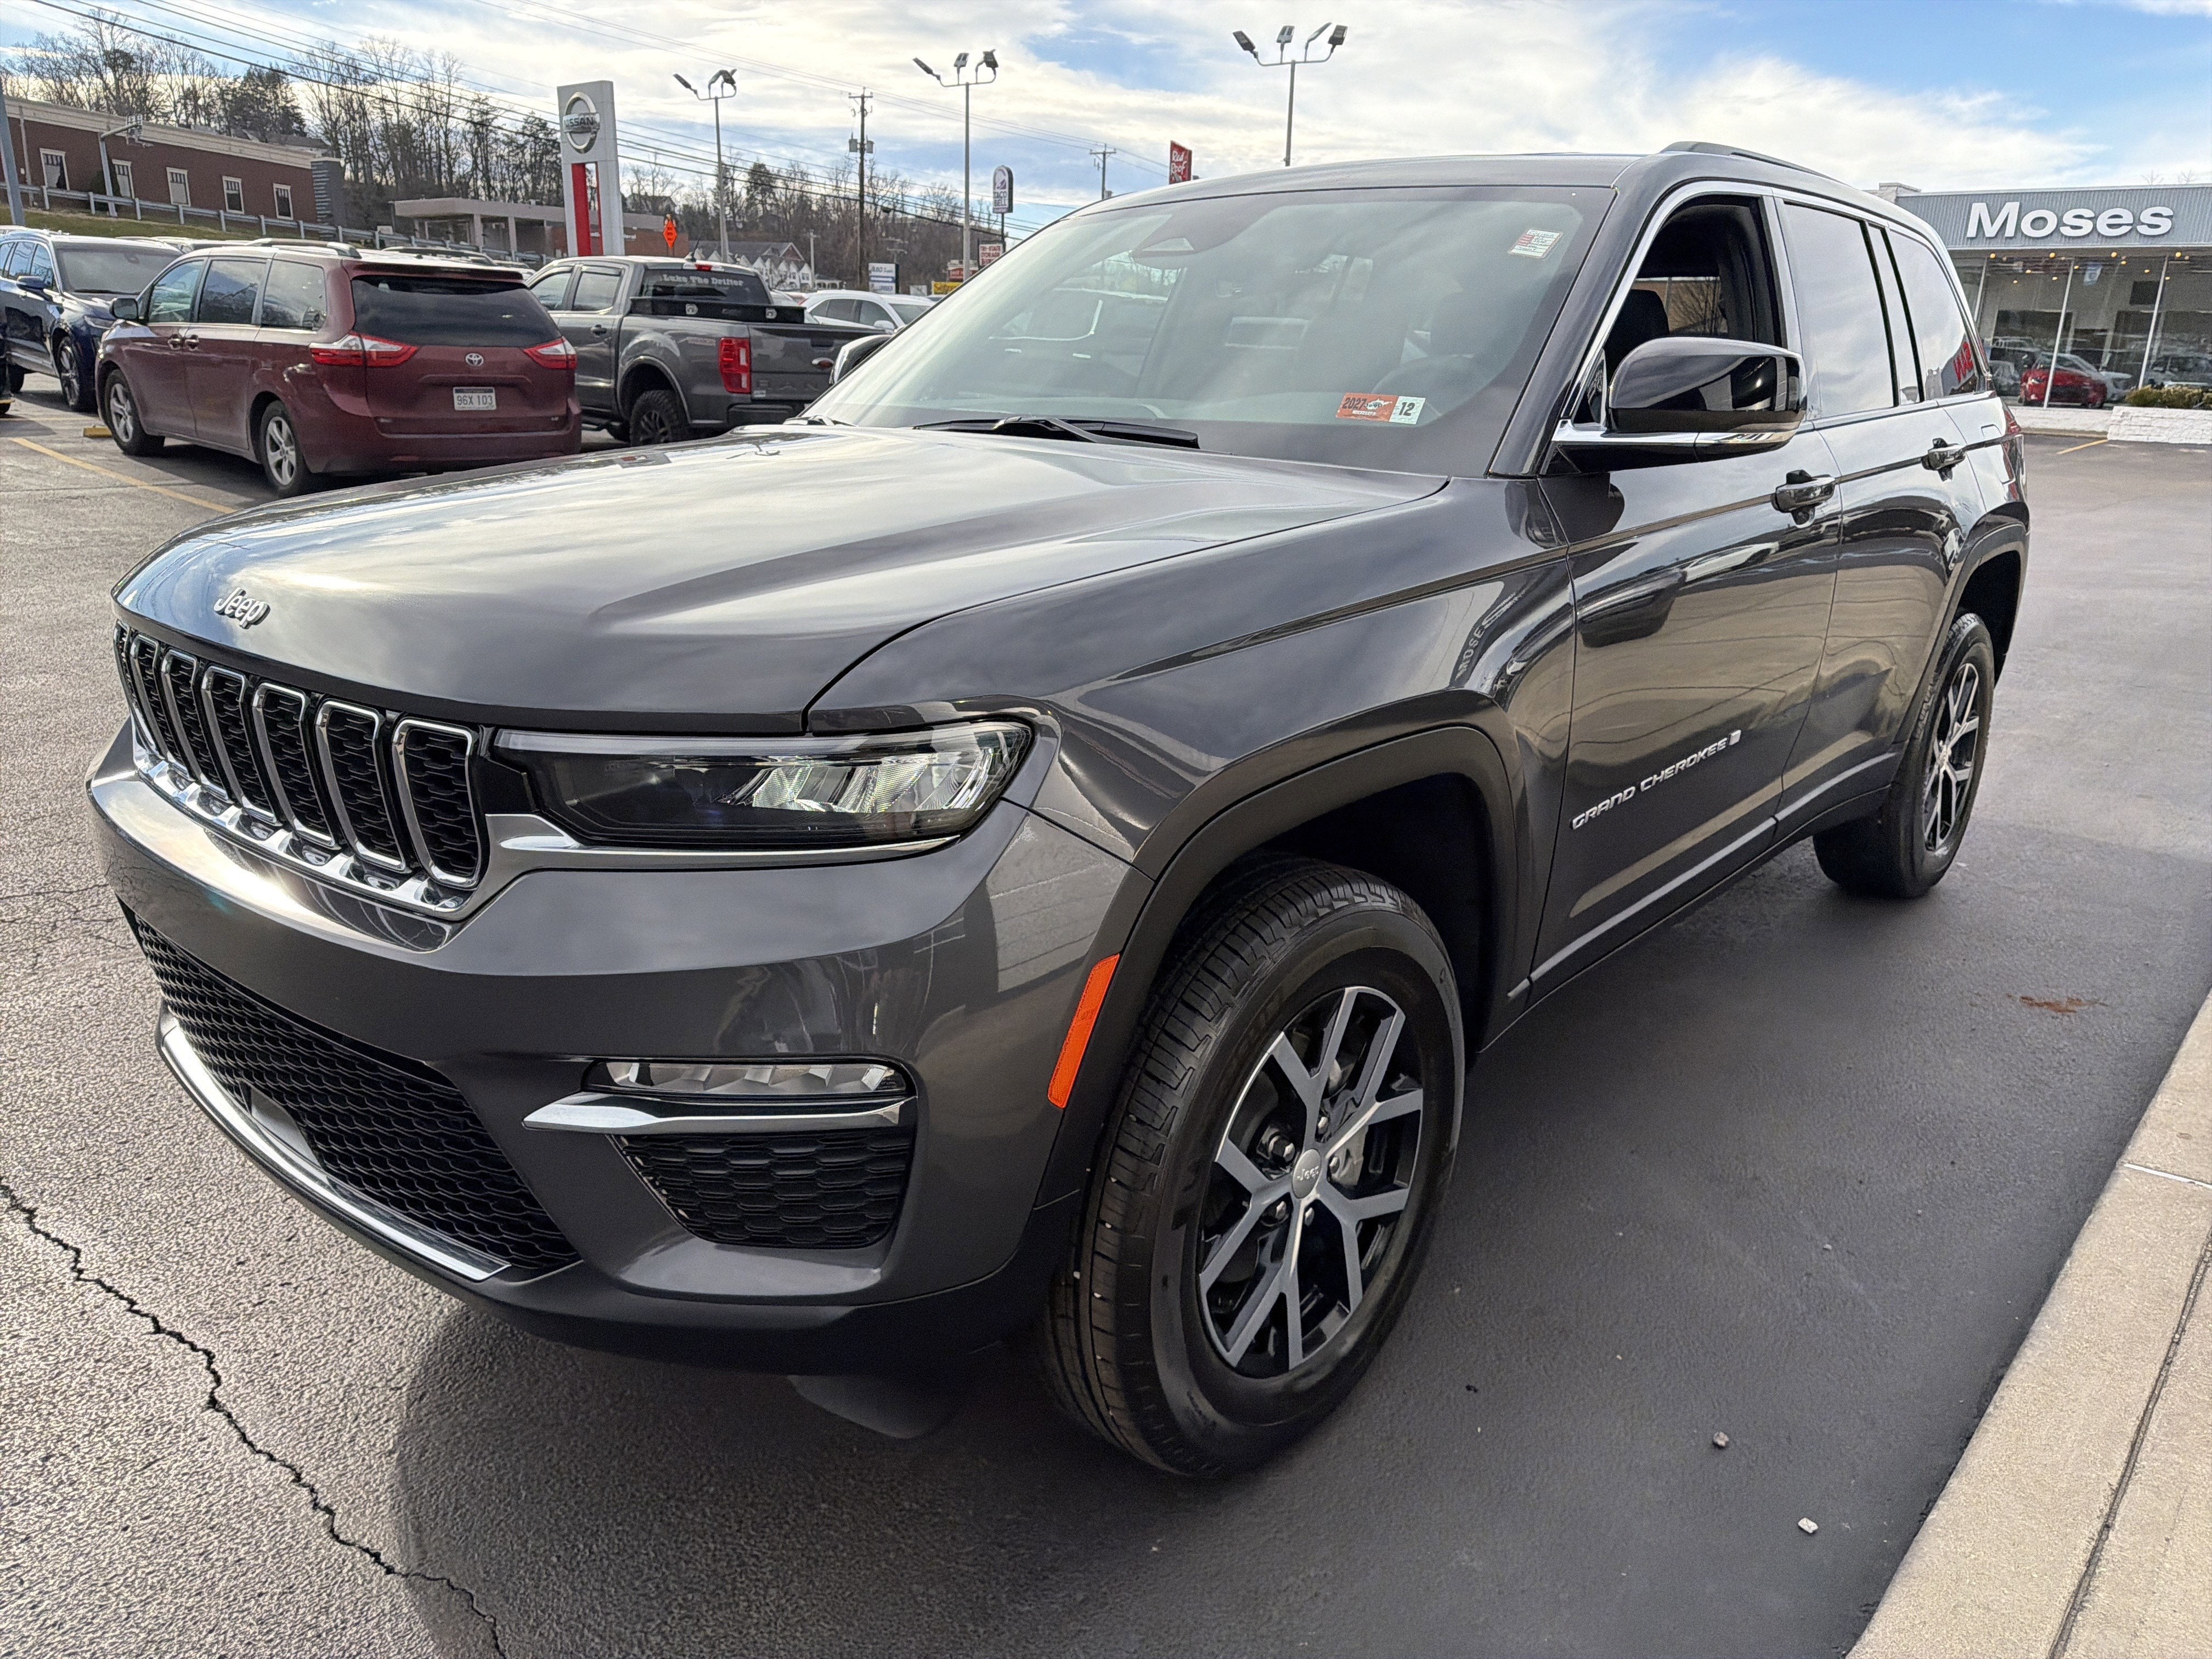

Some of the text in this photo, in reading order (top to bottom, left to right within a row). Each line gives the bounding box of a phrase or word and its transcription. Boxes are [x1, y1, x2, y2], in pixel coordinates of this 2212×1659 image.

[1172, 150, 1185, 162] Red
[1171, 161, 1187, 175] Roof
[994, 198, 1007, 206] BELL
[1966, 201, 2174, 238] Moses
[690, 276, 709, 284] The
[456, 394, 493, 405] 96X 103
[1342, 397, 1415, 416] 2027 12
[213, 586, 269, 628] Jeep
[1572, 737, 1728, 830] GRAND CHEROKEE
[1296, 1166, 1319, 1180] Jeep
